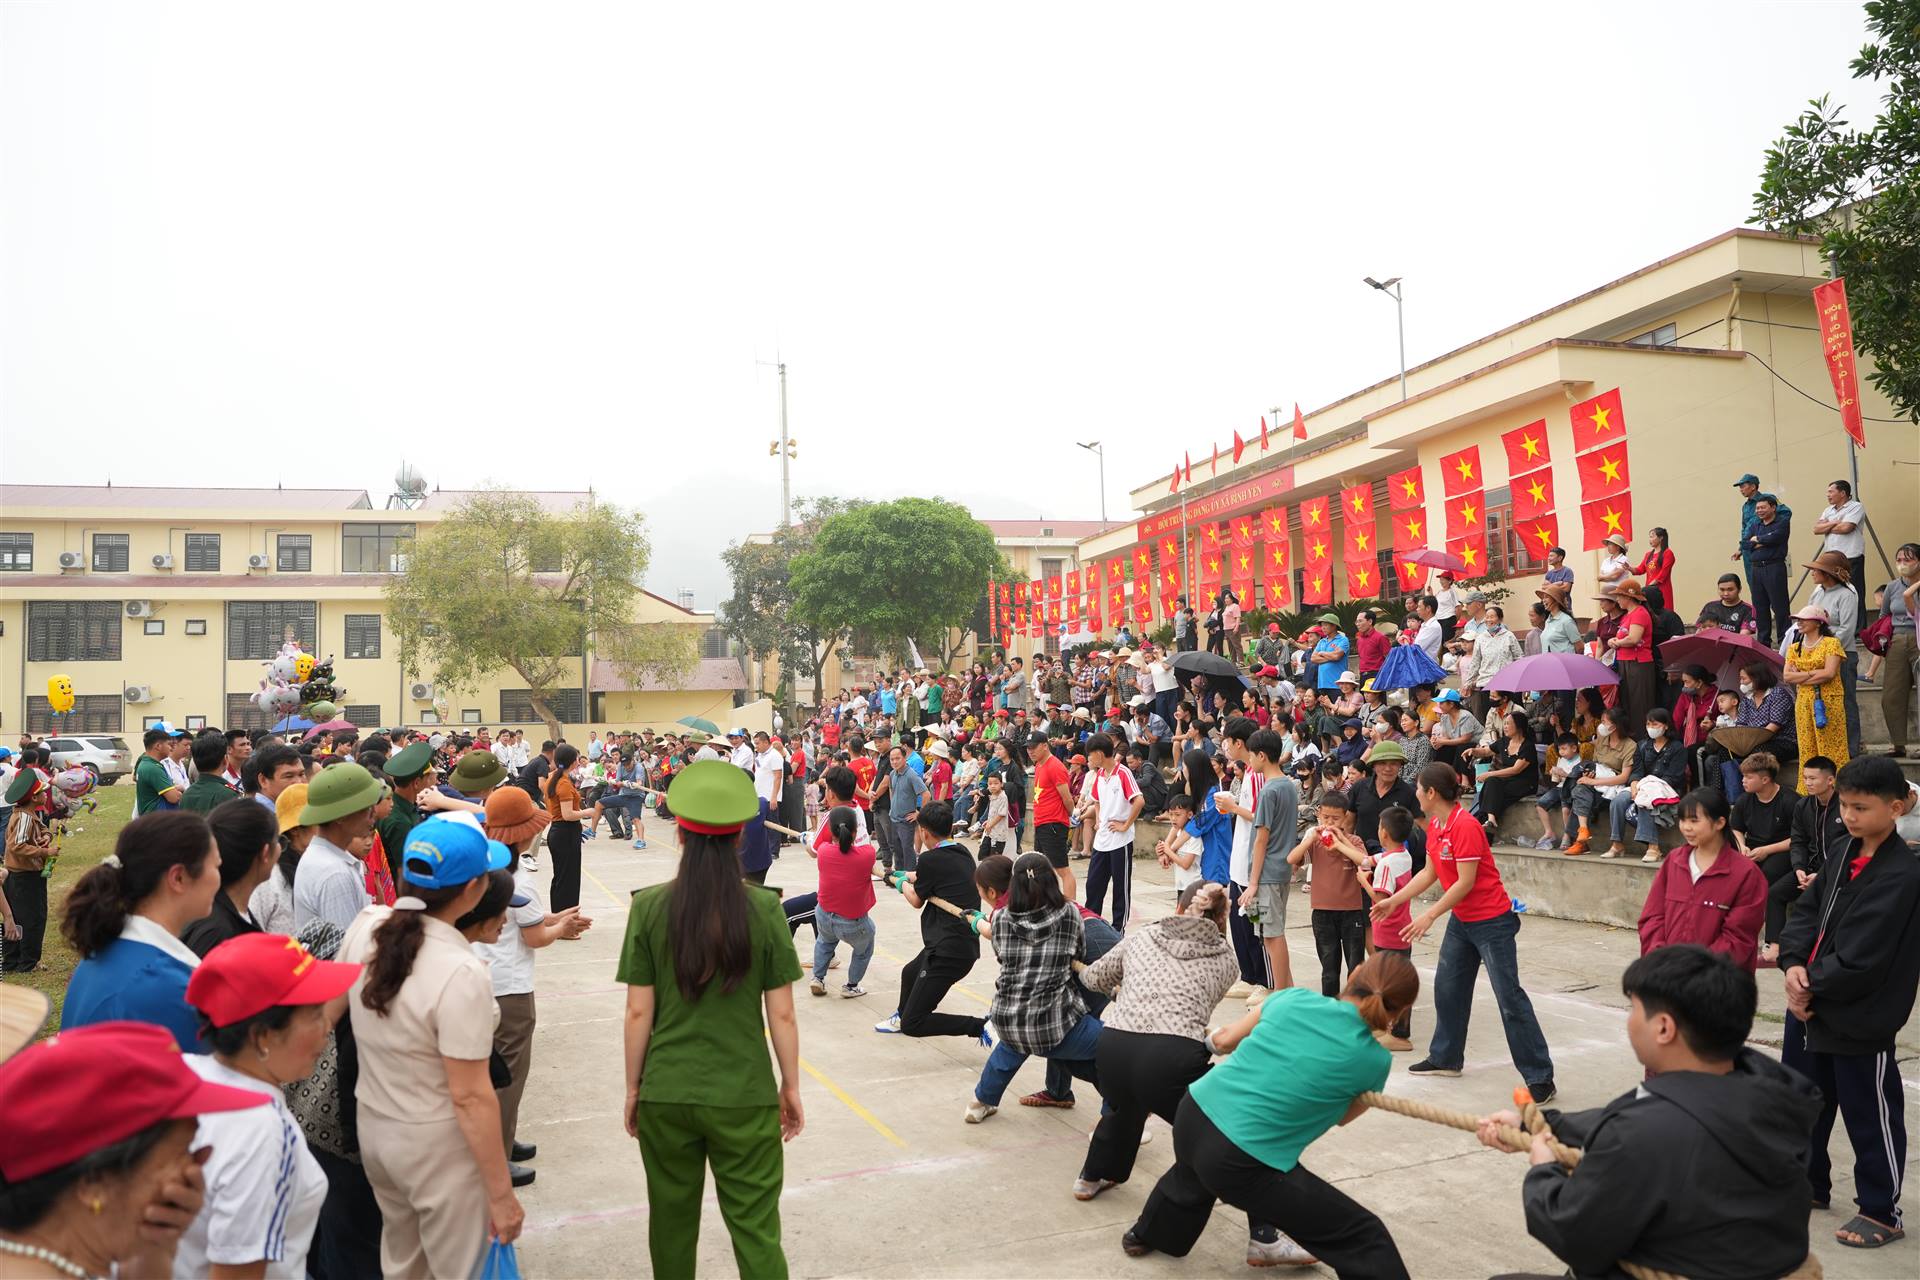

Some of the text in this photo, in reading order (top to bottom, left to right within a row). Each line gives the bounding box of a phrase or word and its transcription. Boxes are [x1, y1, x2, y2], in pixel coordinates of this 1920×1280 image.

[1169, 511, 1193, 526] TRƯNG
[1231, 489, 1247, 505] BÌNH
[1247, 484, 1263, 499] YÊN
